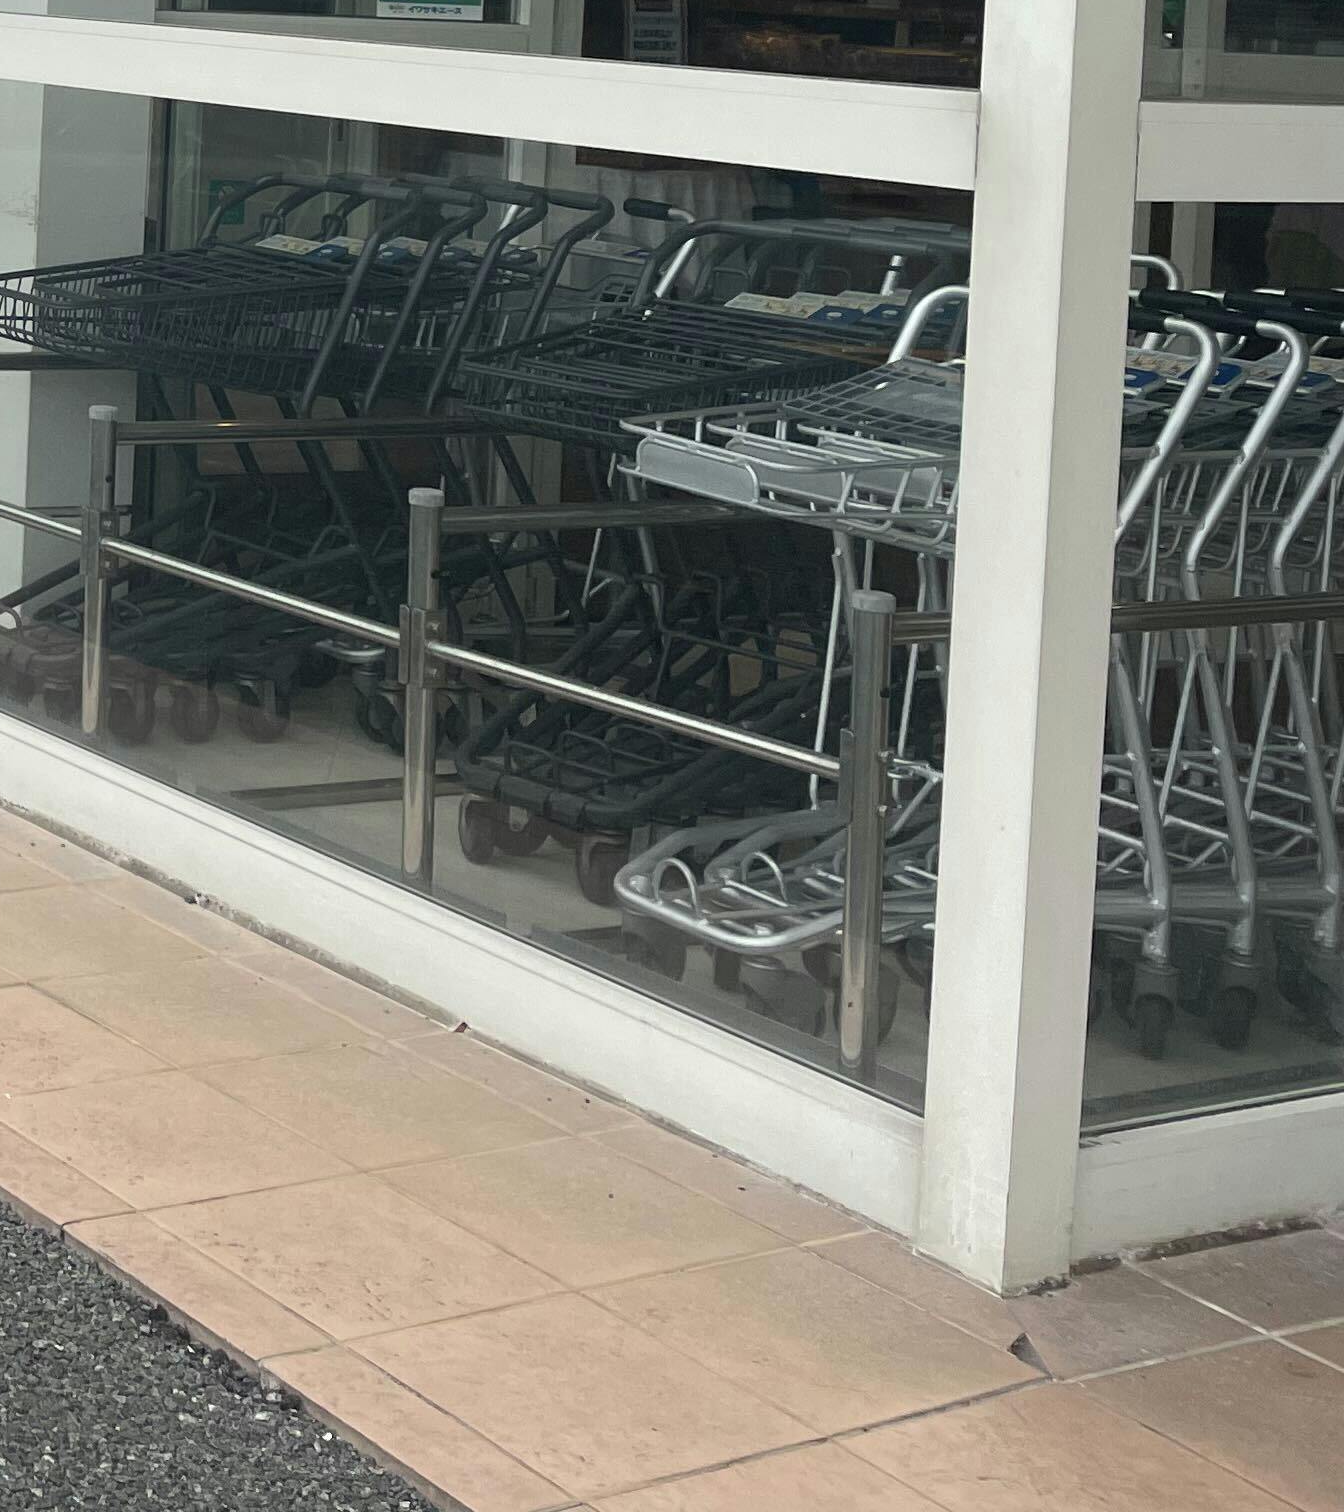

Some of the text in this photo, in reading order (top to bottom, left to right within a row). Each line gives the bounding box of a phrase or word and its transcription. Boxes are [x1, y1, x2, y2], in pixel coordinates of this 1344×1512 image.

[408, 5, 463, 15] イワサキエース
